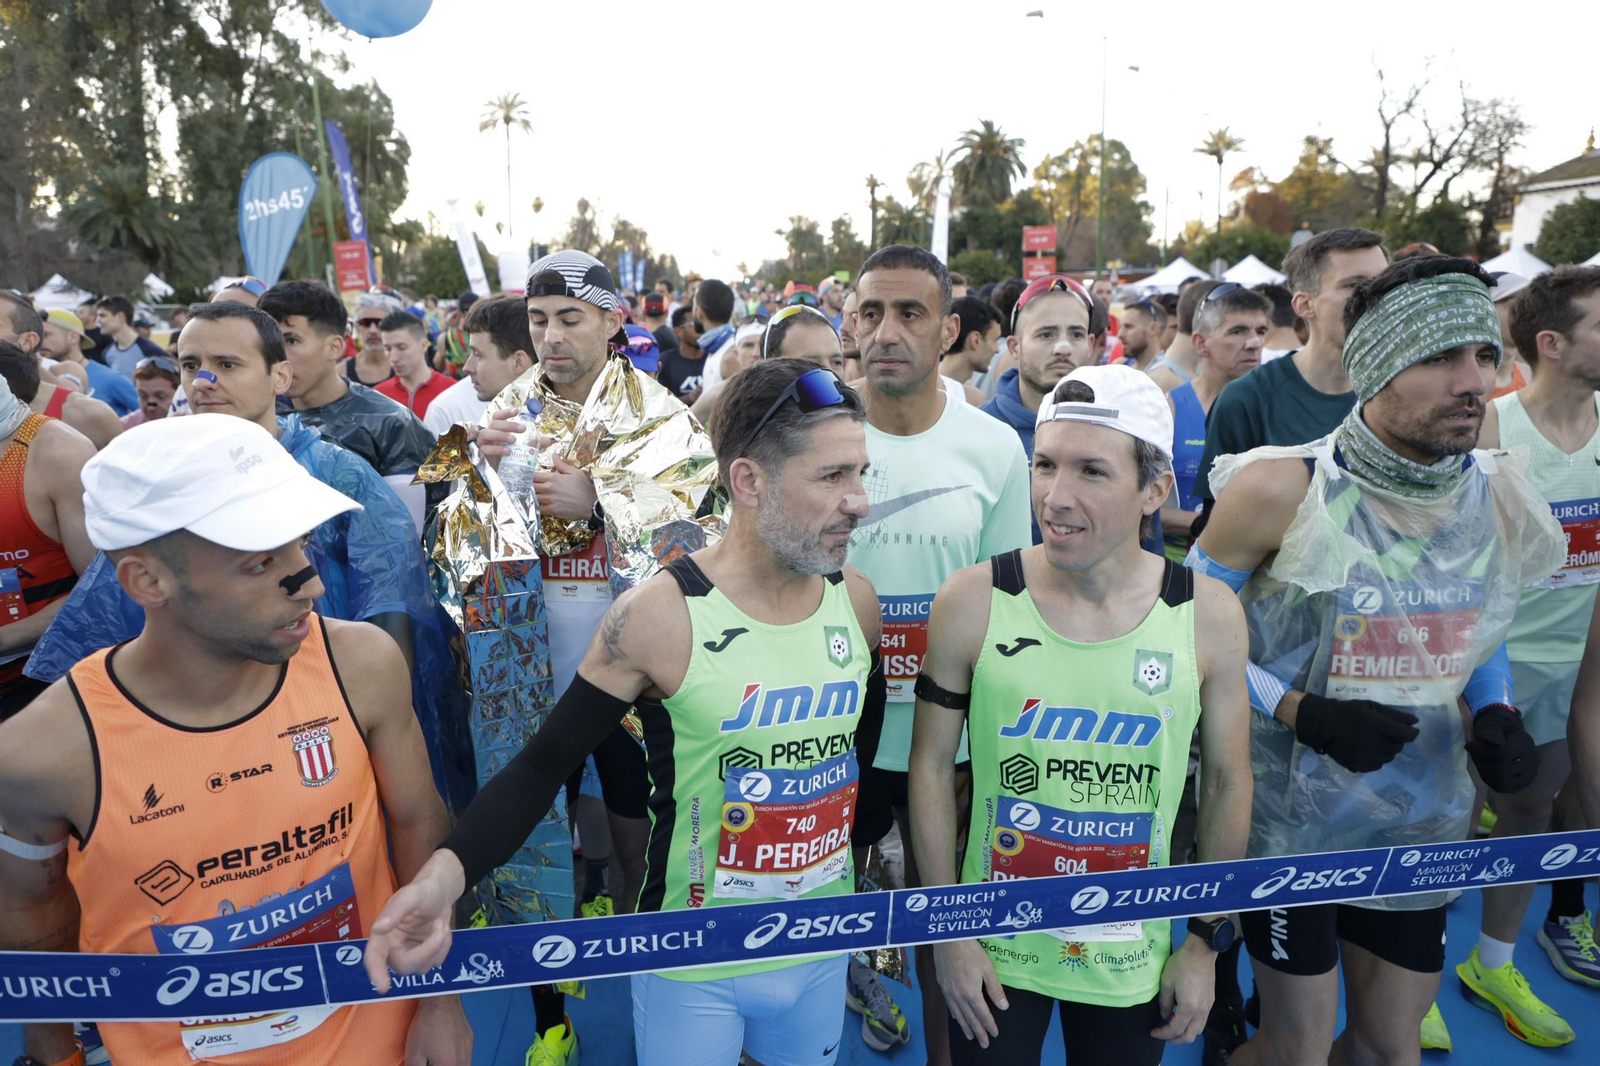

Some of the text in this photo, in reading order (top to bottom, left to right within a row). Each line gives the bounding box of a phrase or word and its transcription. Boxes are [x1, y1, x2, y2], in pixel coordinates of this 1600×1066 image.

[235, 454, 262, 474] ipso
[1553, 503, 1599, 518] URICH
[869, 532, 948, 547] RUNNING
[1394, 586, 1470, 606] ZURICH
[879, 601, 933, 616] ZURIC
[881, 634, 906, 648] 541
[884, 654, 926, 676] ISS
[229, 763, 274, 782] STAR
[781, 763, 847, 796] ZURICH
[1046, 758, 1161, 784] PREVENT
[1070, 780, 1162, 808] SPRAIN
[129, 804, 185, 825] Lacatoni
[787, 815, 817, 835] 740
[1050, 816, 1135, 838] ZURICH
[719, 823, 850, 870] J. PEREIRA
[1024, 834, 1042, 843] ZURICH
[1041, 839, 1067, 850] MARATÓN
[1421, 848, 1480, 863] ZURICH
[1576, 847, 1600, 863] Z
[200, 864, 274, 889] CAIXILHARIAS
[276, 855, 291, 867] DE
[1054, 856, 1087, 877] 604
[1415, 862, 1473, 876] MARATÓN
[733, 877, 755, 887] asics
[1112, 881, 1221, 907] ZURICH
[1290, 865, 1373, 891] asics
[1410, 873, 1466, 887] SEVILLA
[931, 891, 995, 908] ZURICH
[227, 884, 333, 943] ZURICH
[929, 905, 993, 922] MARATÓN
[582, 930, 704, 959] ZURICH
[787, 911, 876, 939] asics
[928, 918, 991, 935] SEVILLA
[267, 935, 291, 949] SEVILLA
[291, 927, 306, 938] 2025
[0, 976, 112, 998] URICH
[204, 965, 304, 997] asics
[371, 972, 446, 991] VILLA
[206, 1034, 232, 1044] asics
